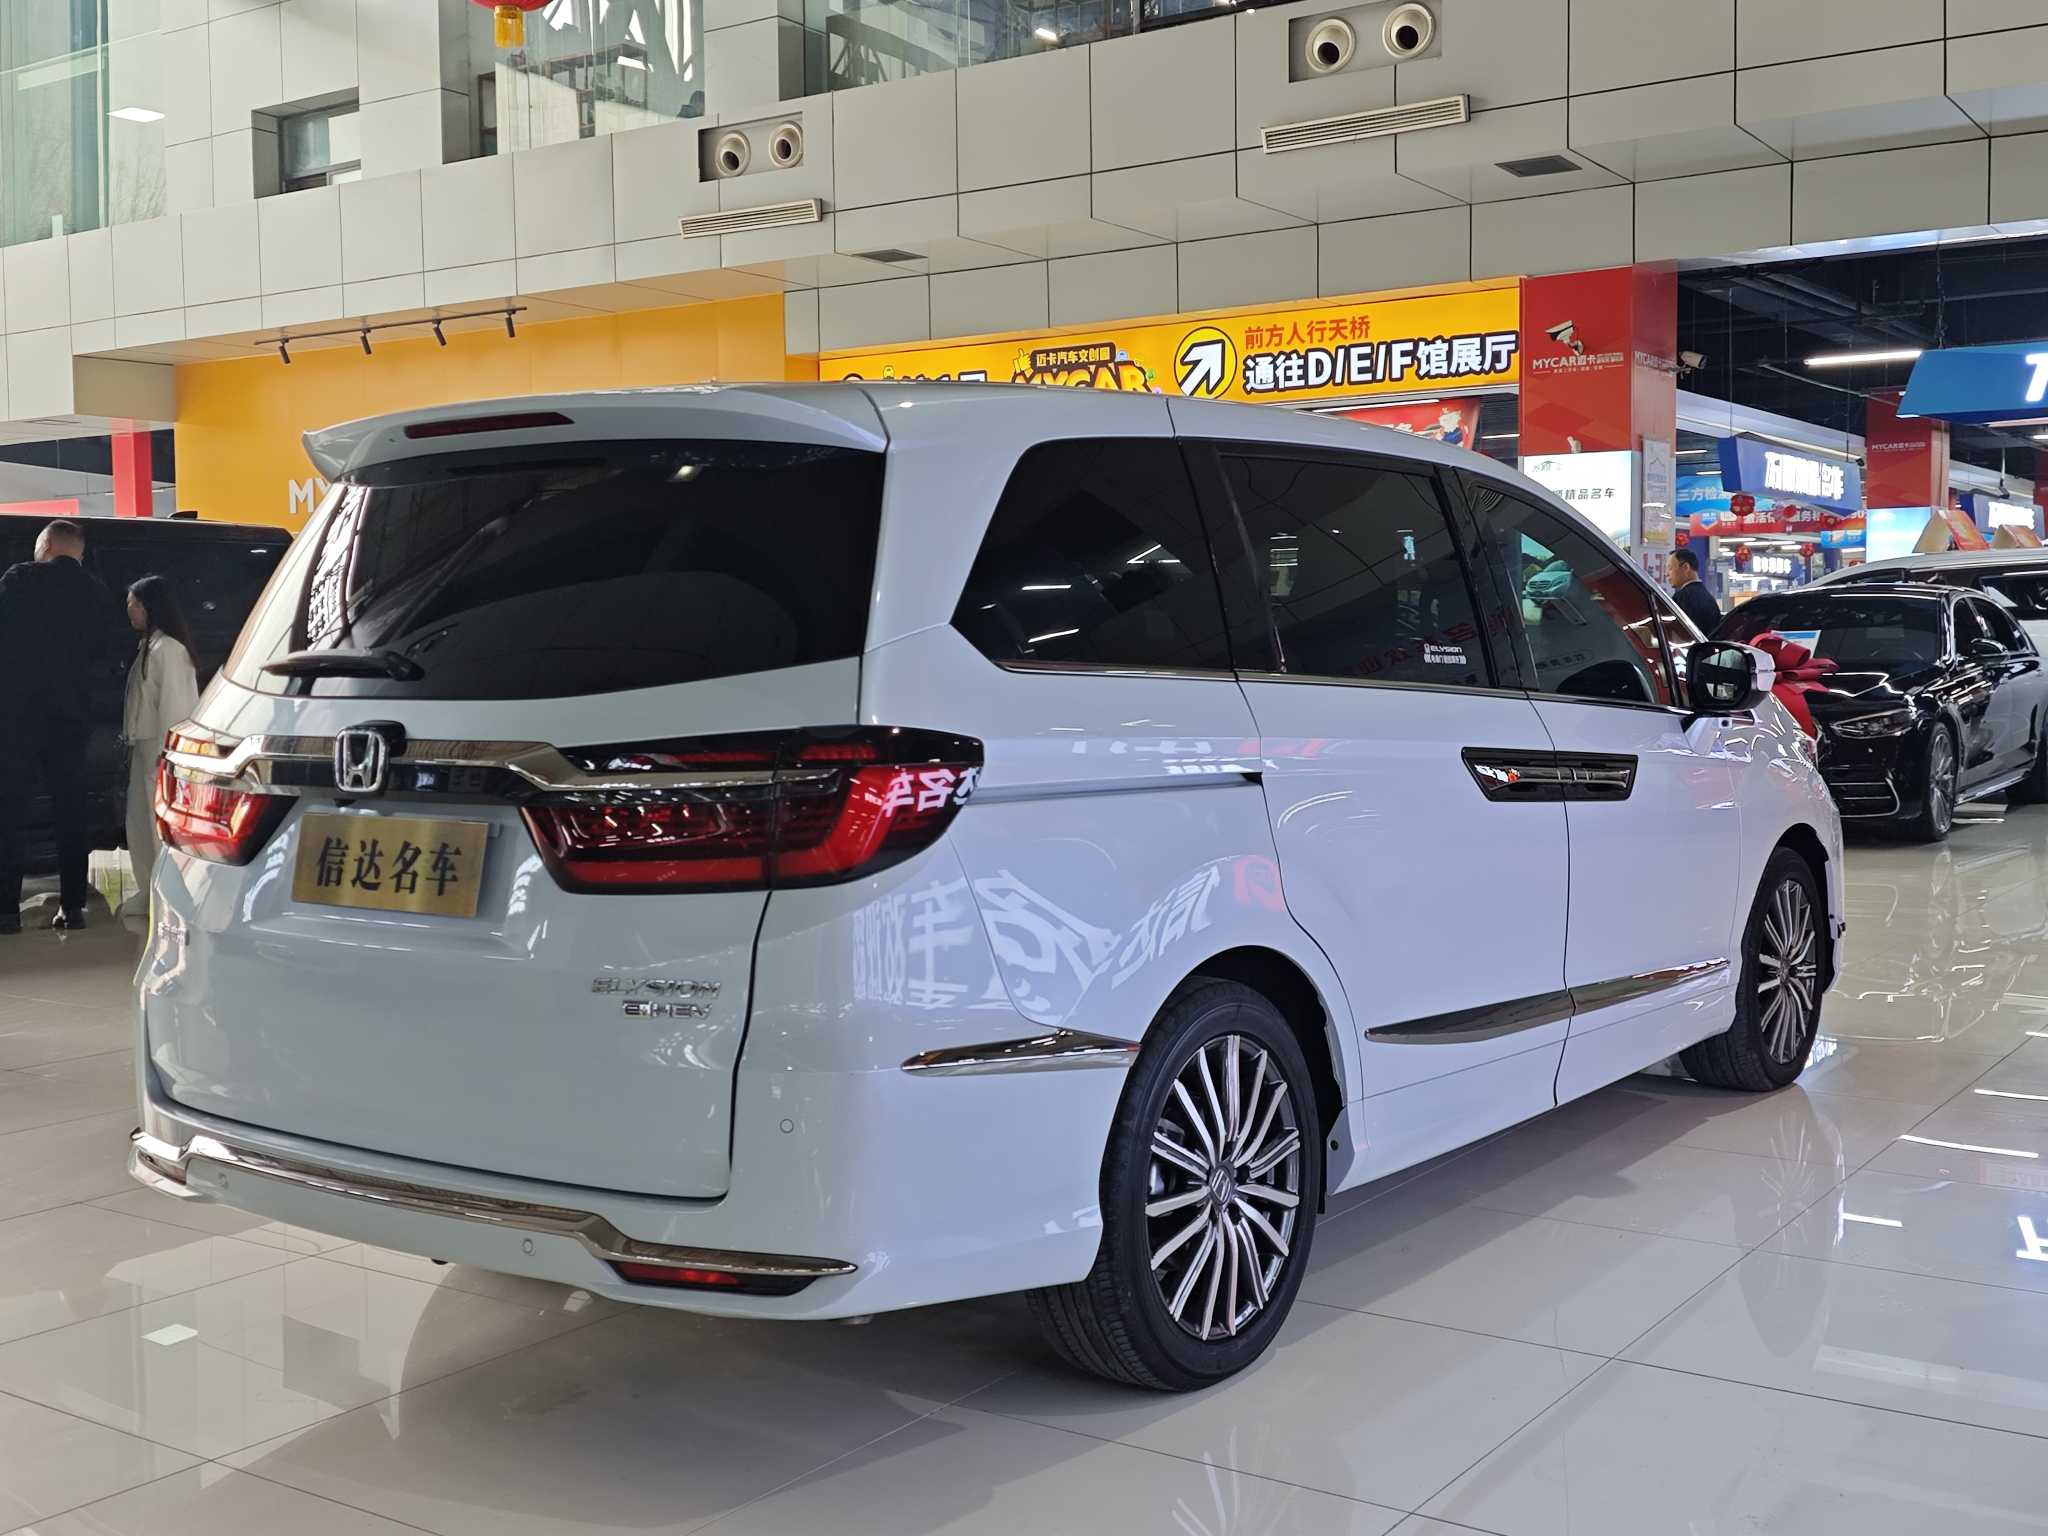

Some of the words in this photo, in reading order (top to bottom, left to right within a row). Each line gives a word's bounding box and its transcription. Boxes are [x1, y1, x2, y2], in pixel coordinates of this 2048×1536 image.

[1244, 315, 1371, 350] 前方人行天桥
[1245, 333, 1517, 391] 通往D/E/F馆展厅
[317, 835, 462, 897] 信达名车
[592, 978, 720, 998] ELYSION
